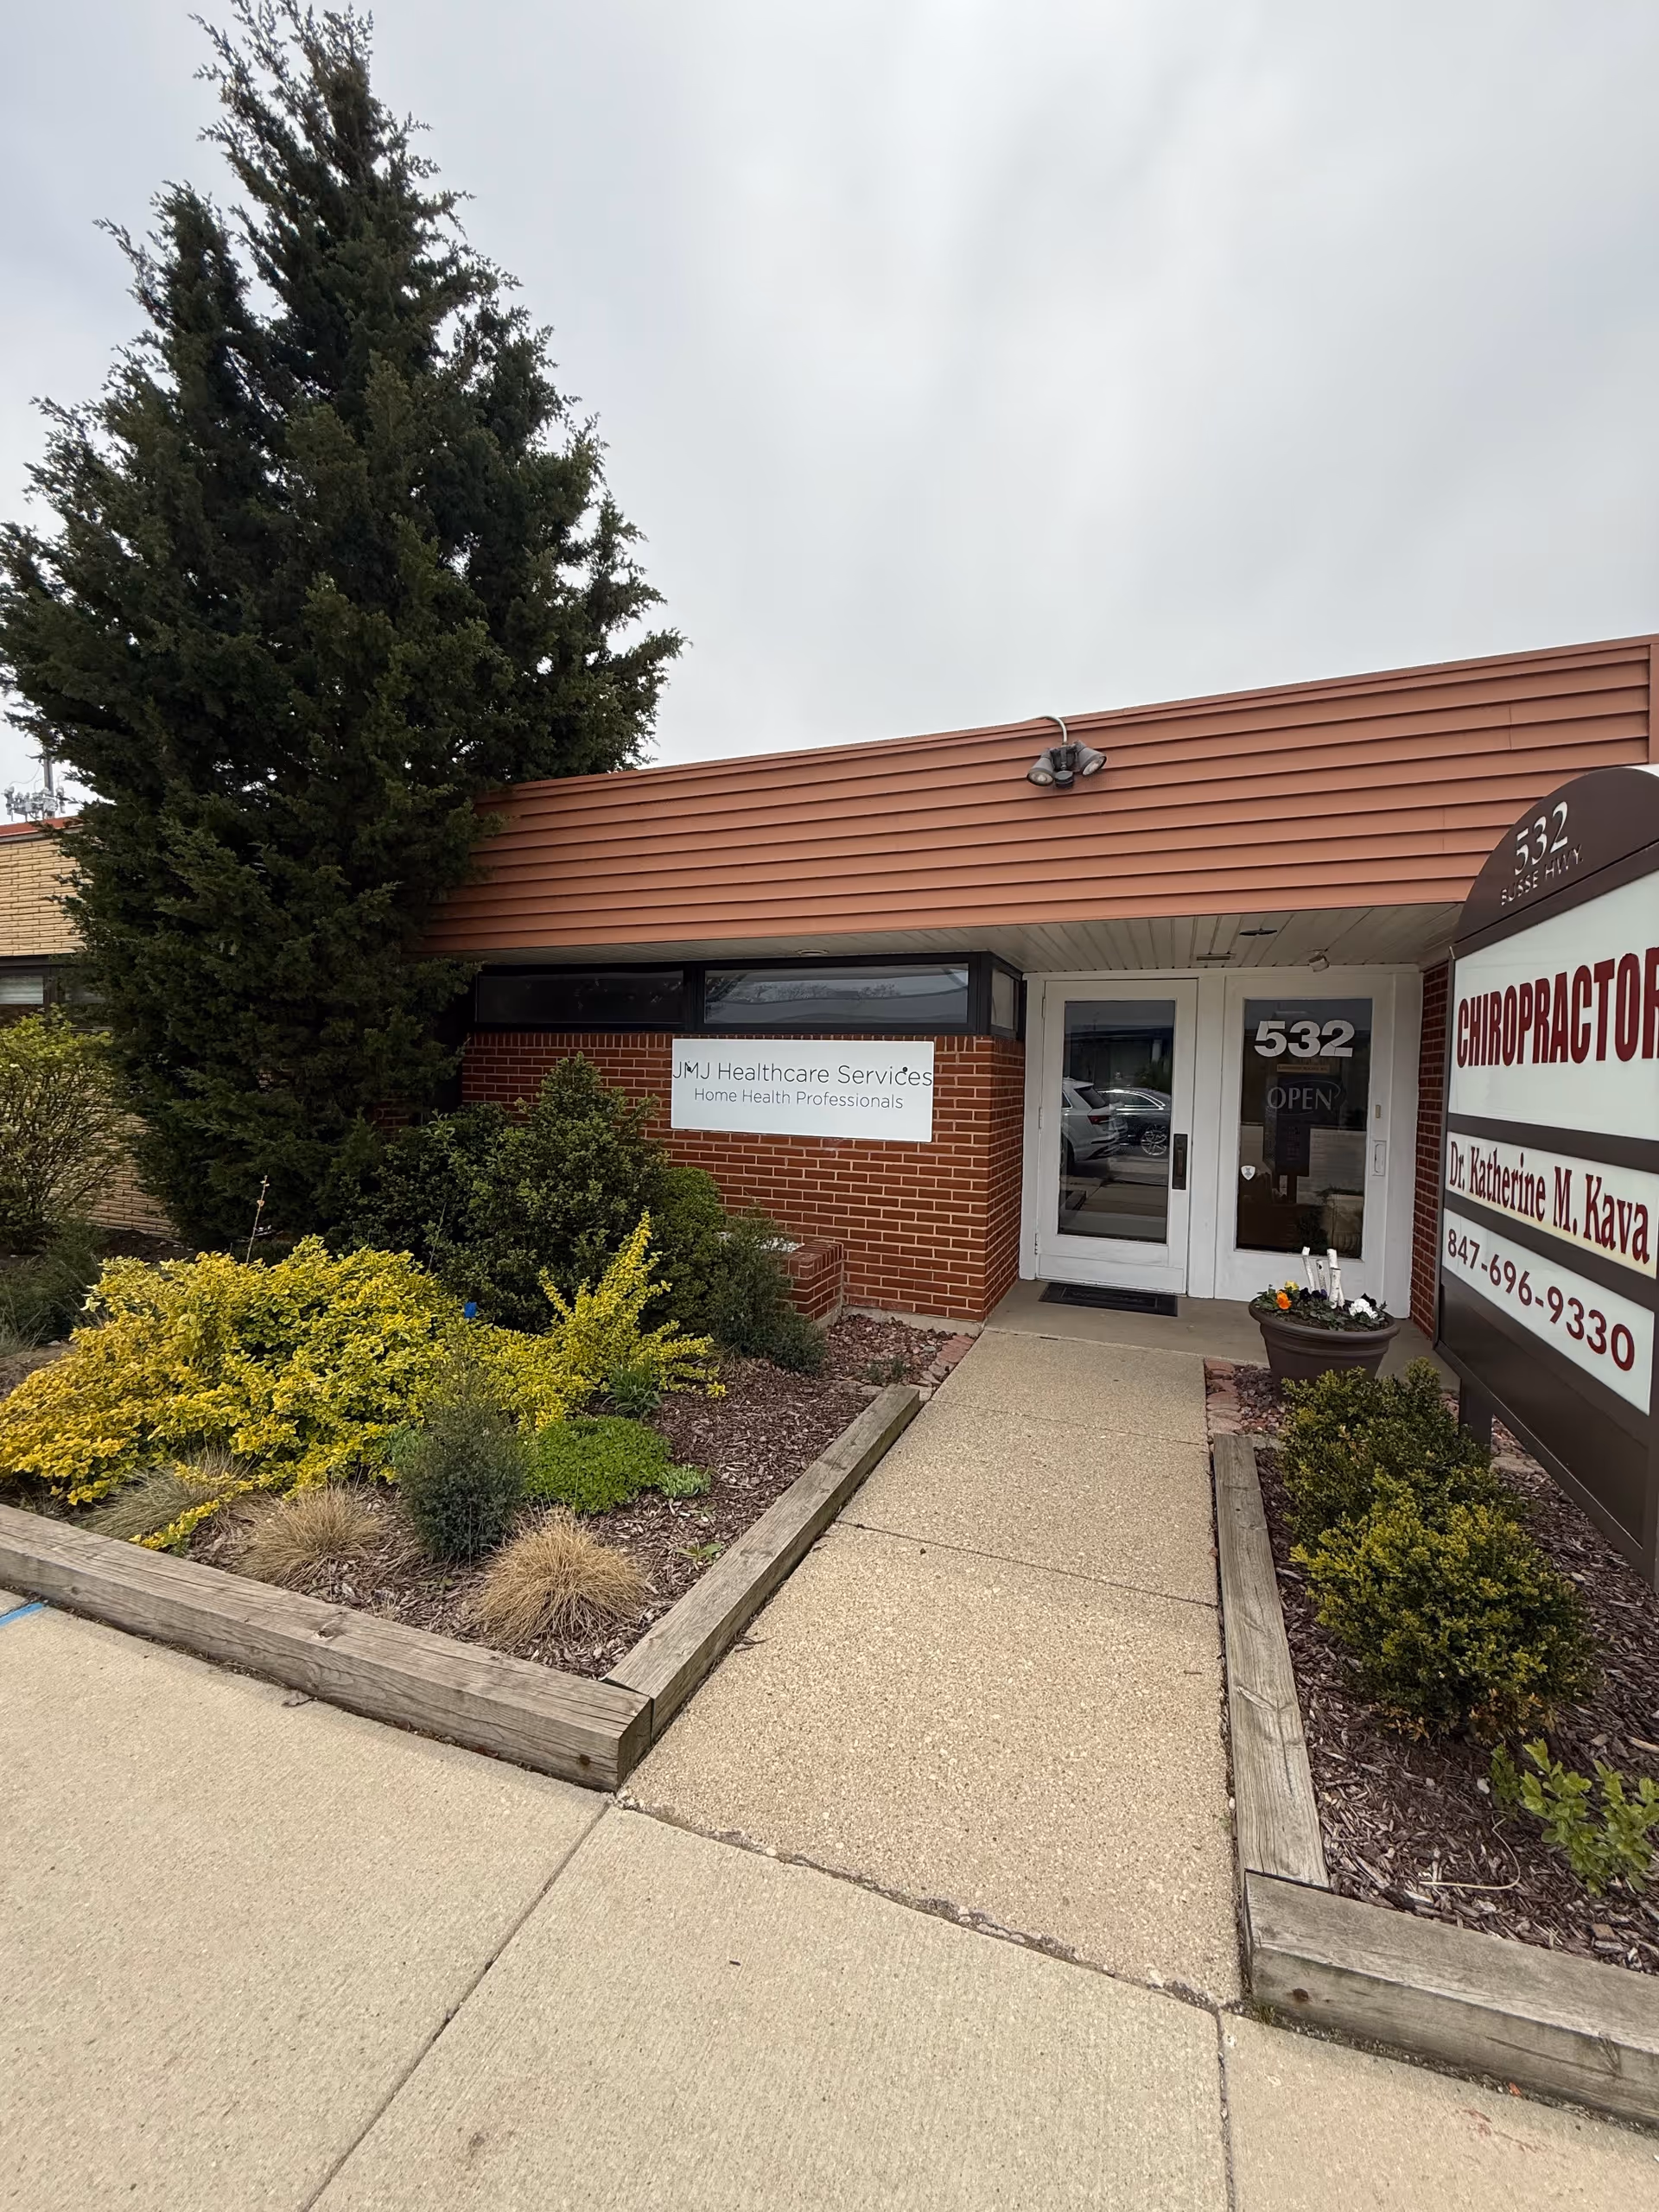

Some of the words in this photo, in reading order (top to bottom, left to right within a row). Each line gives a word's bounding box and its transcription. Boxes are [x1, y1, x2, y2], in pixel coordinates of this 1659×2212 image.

[1515, 801, 1568, 876] 532
[1456, 946, 1659, 1068] CHIROPRACTOR
[1254, 1020, 1356, 1058] 532
[672, 1061, 710, 1080] JMJ
[717, 1063, 830, 1084] Healthcare
[837, 1065, 933, 1087] Services
[694, 1087, 737, 1103] Home
[741, 1089, 791, 1105] Health
[796, 1091, 904, 1109] Professionals
[1267, 1086, 1332, 1111] OPEN
[1449, 1141, 1466, 1192] Dr.
[1469, 1146, 1547, 1223] Katherine
[1554, 1165, 1578, 1236] M.
[1583, 1173, 1650, 1265] Kava
[1447, 1228, 1636, 1372] 847-696-9330
